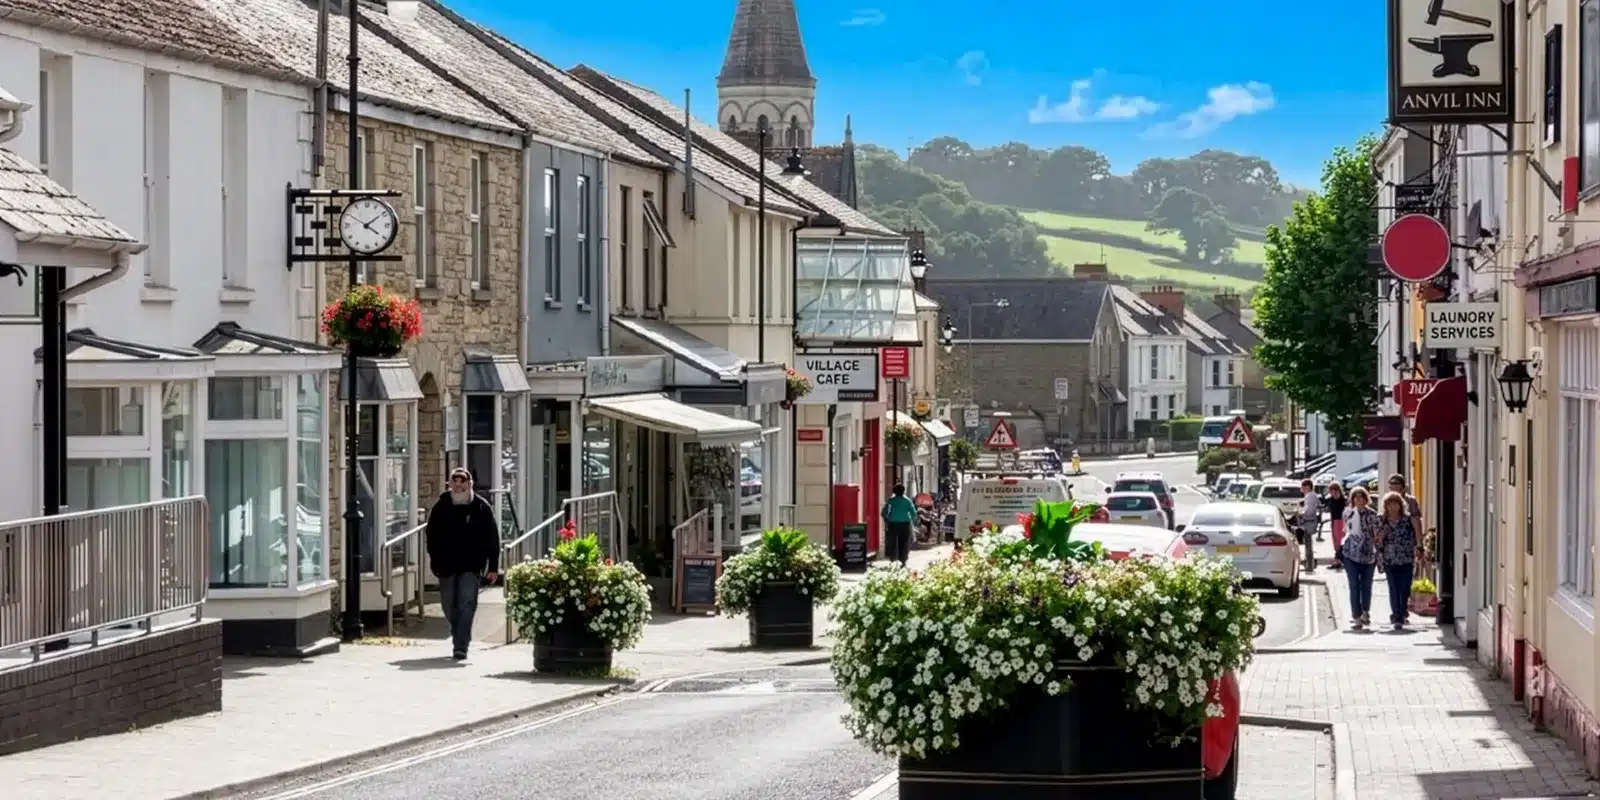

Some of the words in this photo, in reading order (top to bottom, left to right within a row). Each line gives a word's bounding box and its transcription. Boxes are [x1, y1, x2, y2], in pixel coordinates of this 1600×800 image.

[1402, 93, 1460, 109] ANVIL
[1465, 92, 1501, 108] INN
[1431, 326, 1495, 339] SERVICES
[806, 359, 860, 371] VILLAGE
[816, 373, 850, 385] CAFE
